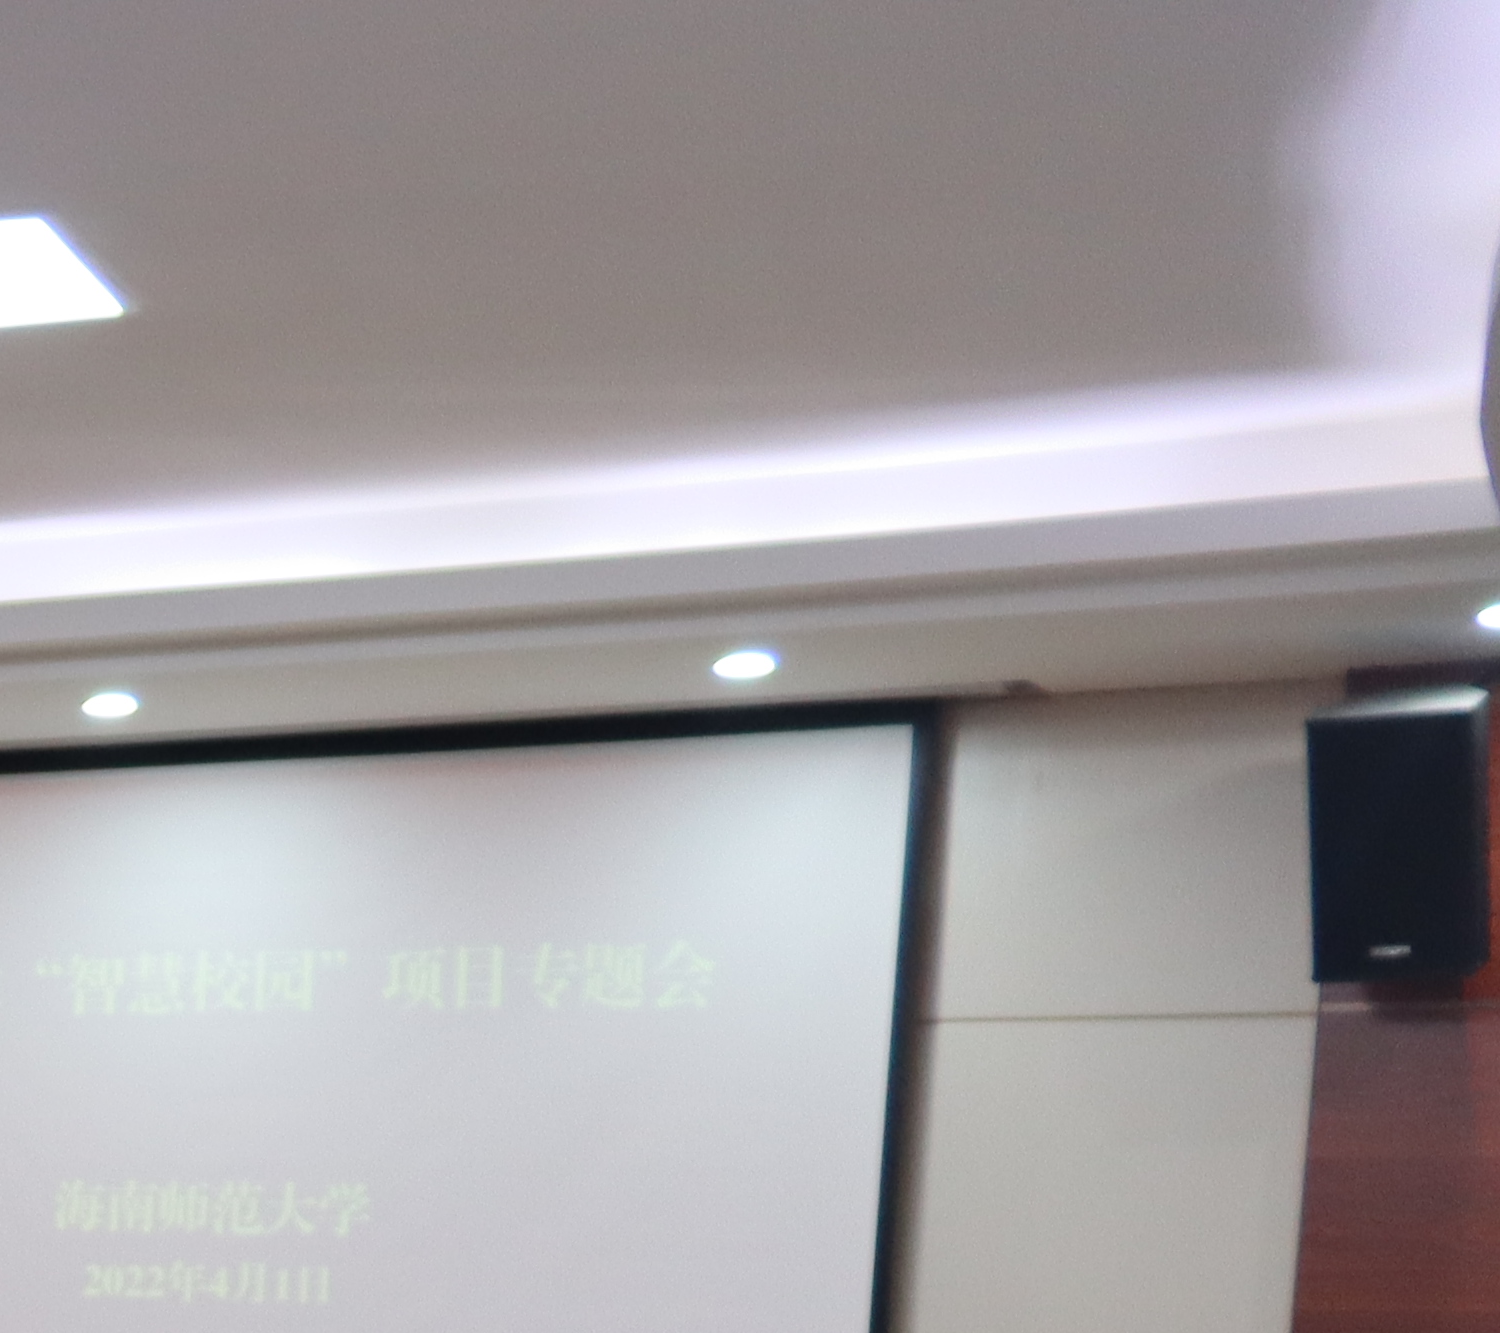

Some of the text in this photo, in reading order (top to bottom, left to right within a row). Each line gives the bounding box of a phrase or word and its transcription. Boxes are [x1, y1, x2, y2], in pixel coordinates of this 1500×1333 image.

[56, 1179, 372, 1238] 海南师范大学
[82, 1259, 331, 1303] 2022年4月1日
